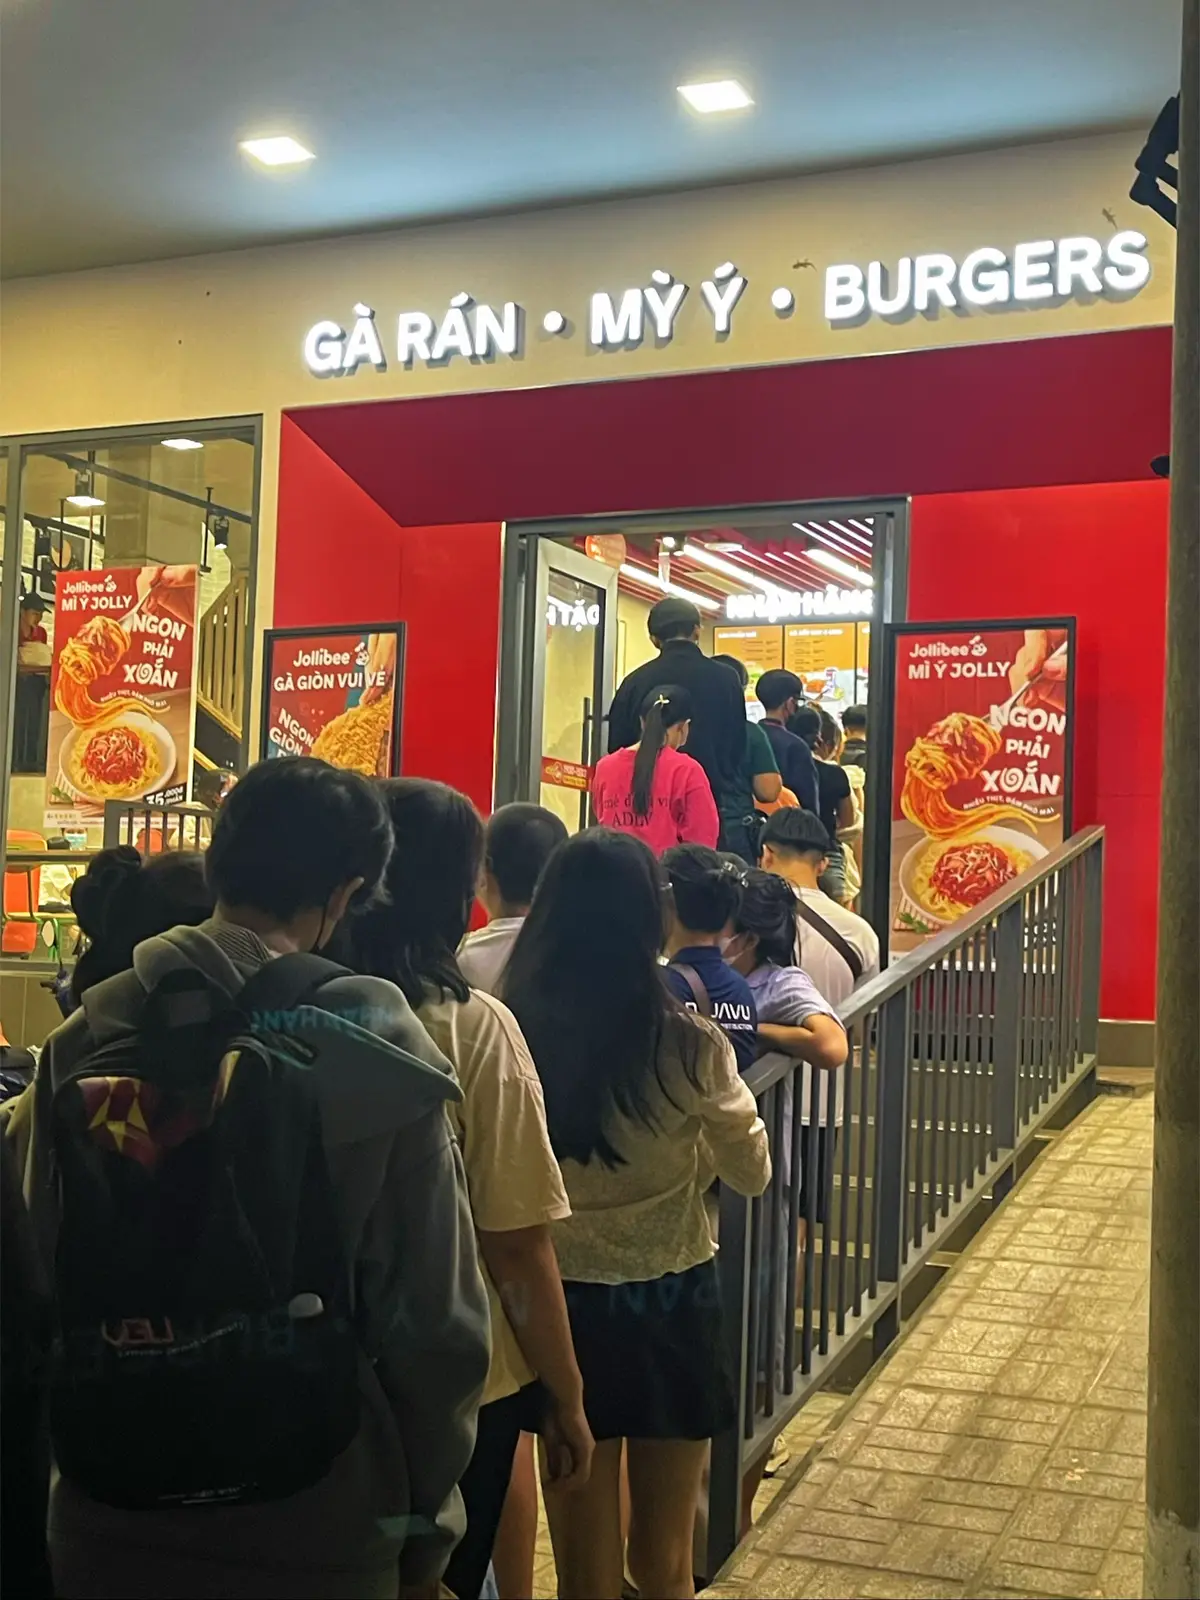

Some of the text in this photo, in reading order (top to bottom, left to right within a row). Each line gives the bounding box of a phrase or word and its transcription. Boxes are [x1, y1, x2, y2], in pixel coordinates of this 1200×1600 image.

[303, 230, 1150, 372] GÀ RÁN MỲ Ý BURGERS
[62, 580, 104, 595] Jollibee
[61, 595, 77, 611] MÌ
[90, 595, 132, 610] JOLLY
[132, 612, 187, 641] NGON
[143, 639, 174, 659] PHẢI
[293, 648, 351, 667] Jollibee
[909, 641, 969, 658] Jollibee
[273, 664, 386, 692] GÀ GIÒN VUI VẺ
[908, 659, 1010, 679] MÌ Ý JOLLY
[278, 707, 315, 748] NGON
[989, 704, 1067, 736] NGON
[269, 726, 303, 756] GIÒN
[1005, 735, 1051, 759] PHẢI
[980, 760, 1061, 795] XOẮN
